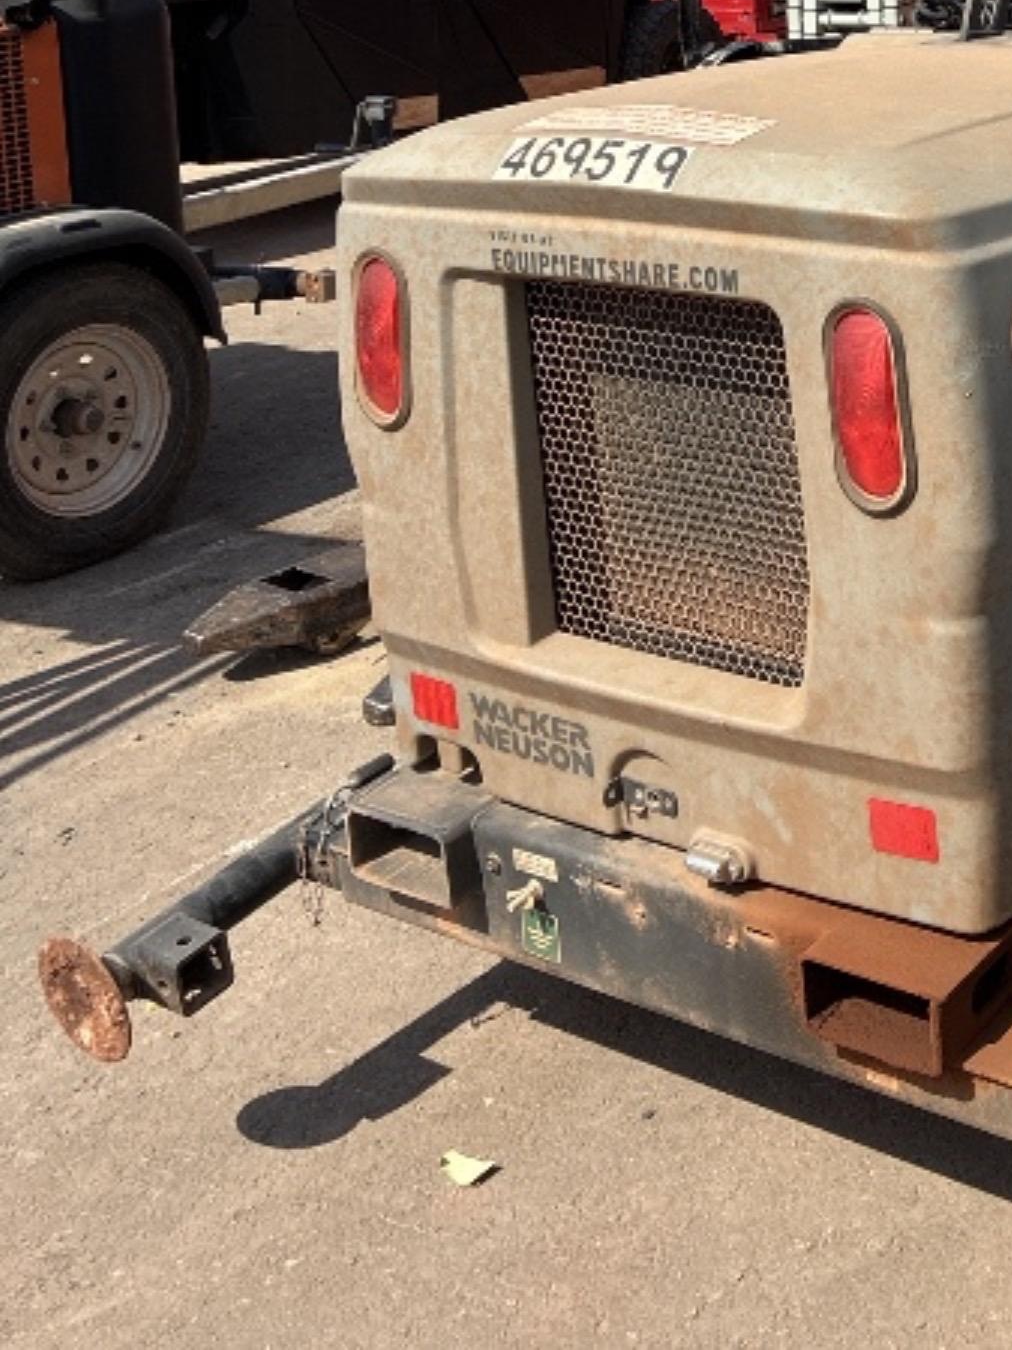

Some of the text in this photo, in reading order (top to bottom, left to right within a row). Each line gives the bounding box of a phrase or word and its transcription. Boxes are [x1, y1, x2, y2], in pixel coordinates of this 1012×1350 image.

[500, 137, 688, 189] 469519
[492, 248, 739, 292] EQUIPMENTSHARE.COM
[470, 692, 592, 751] WACKER
[473, 719, 595, 778] NEUSON
